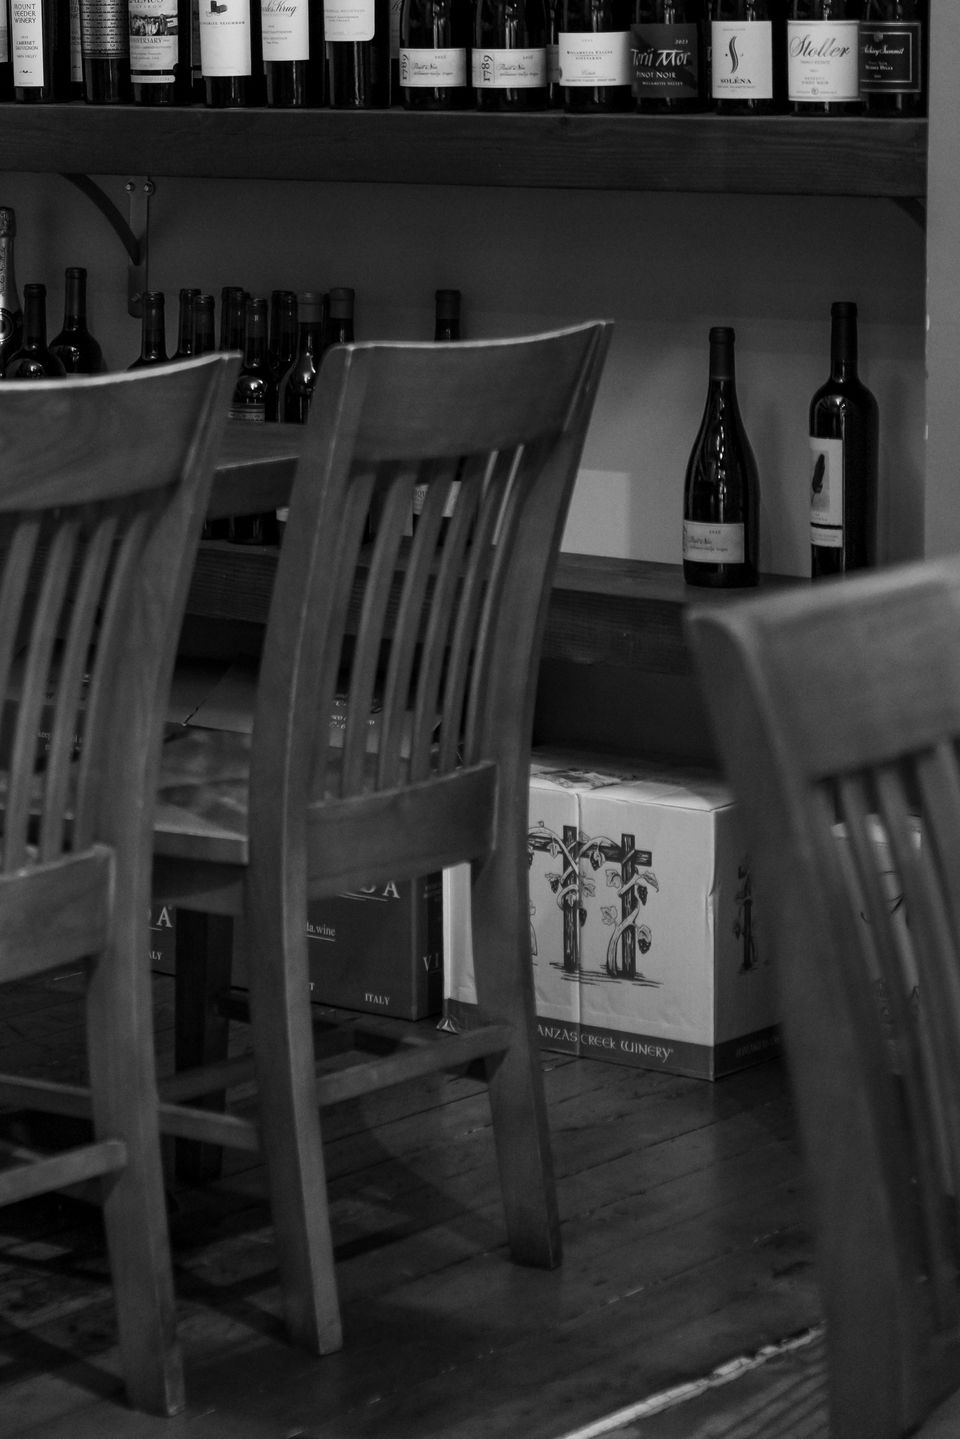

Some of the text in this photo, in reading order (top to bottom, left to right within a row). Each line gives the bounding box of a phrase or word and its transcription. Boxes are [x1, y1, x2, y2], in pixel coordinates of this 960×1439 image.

[274, 0, 297, 18] Krug
[789, 33, 851, 58] Stoller
[401, 53, 409, 81] 1789
[655, 48, 692, 67] Mor
[481, 54, 494, 82] 1789
[655, 70, 677, 79] NOIR
[720, 75, 752, 85] SOLÉNA
[363, 992, 391, 1007] ITALY
[537, 1023, 579, 1044] ANZAS
